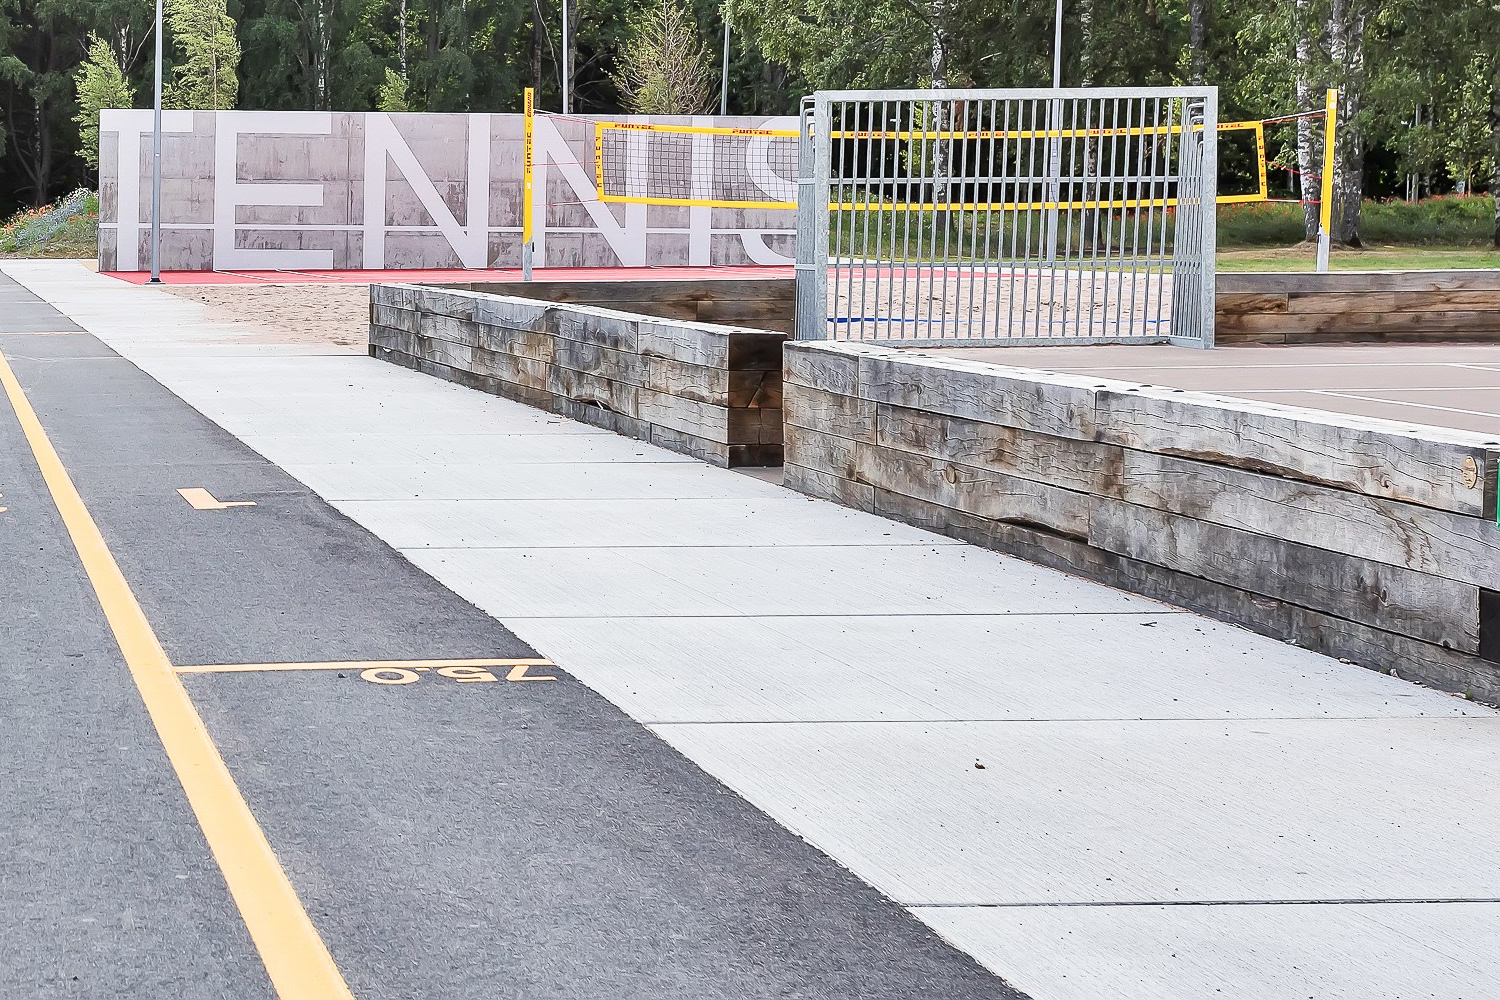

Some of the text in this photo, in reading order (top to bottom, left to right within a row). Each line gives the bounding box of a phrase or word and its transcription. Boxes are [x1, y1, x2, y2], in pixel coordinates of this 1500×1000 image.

[100, 109, 800, 272] TENNIS
[175, 487, 258, 510] 1
[359, 664, 558, 685] 75.0
